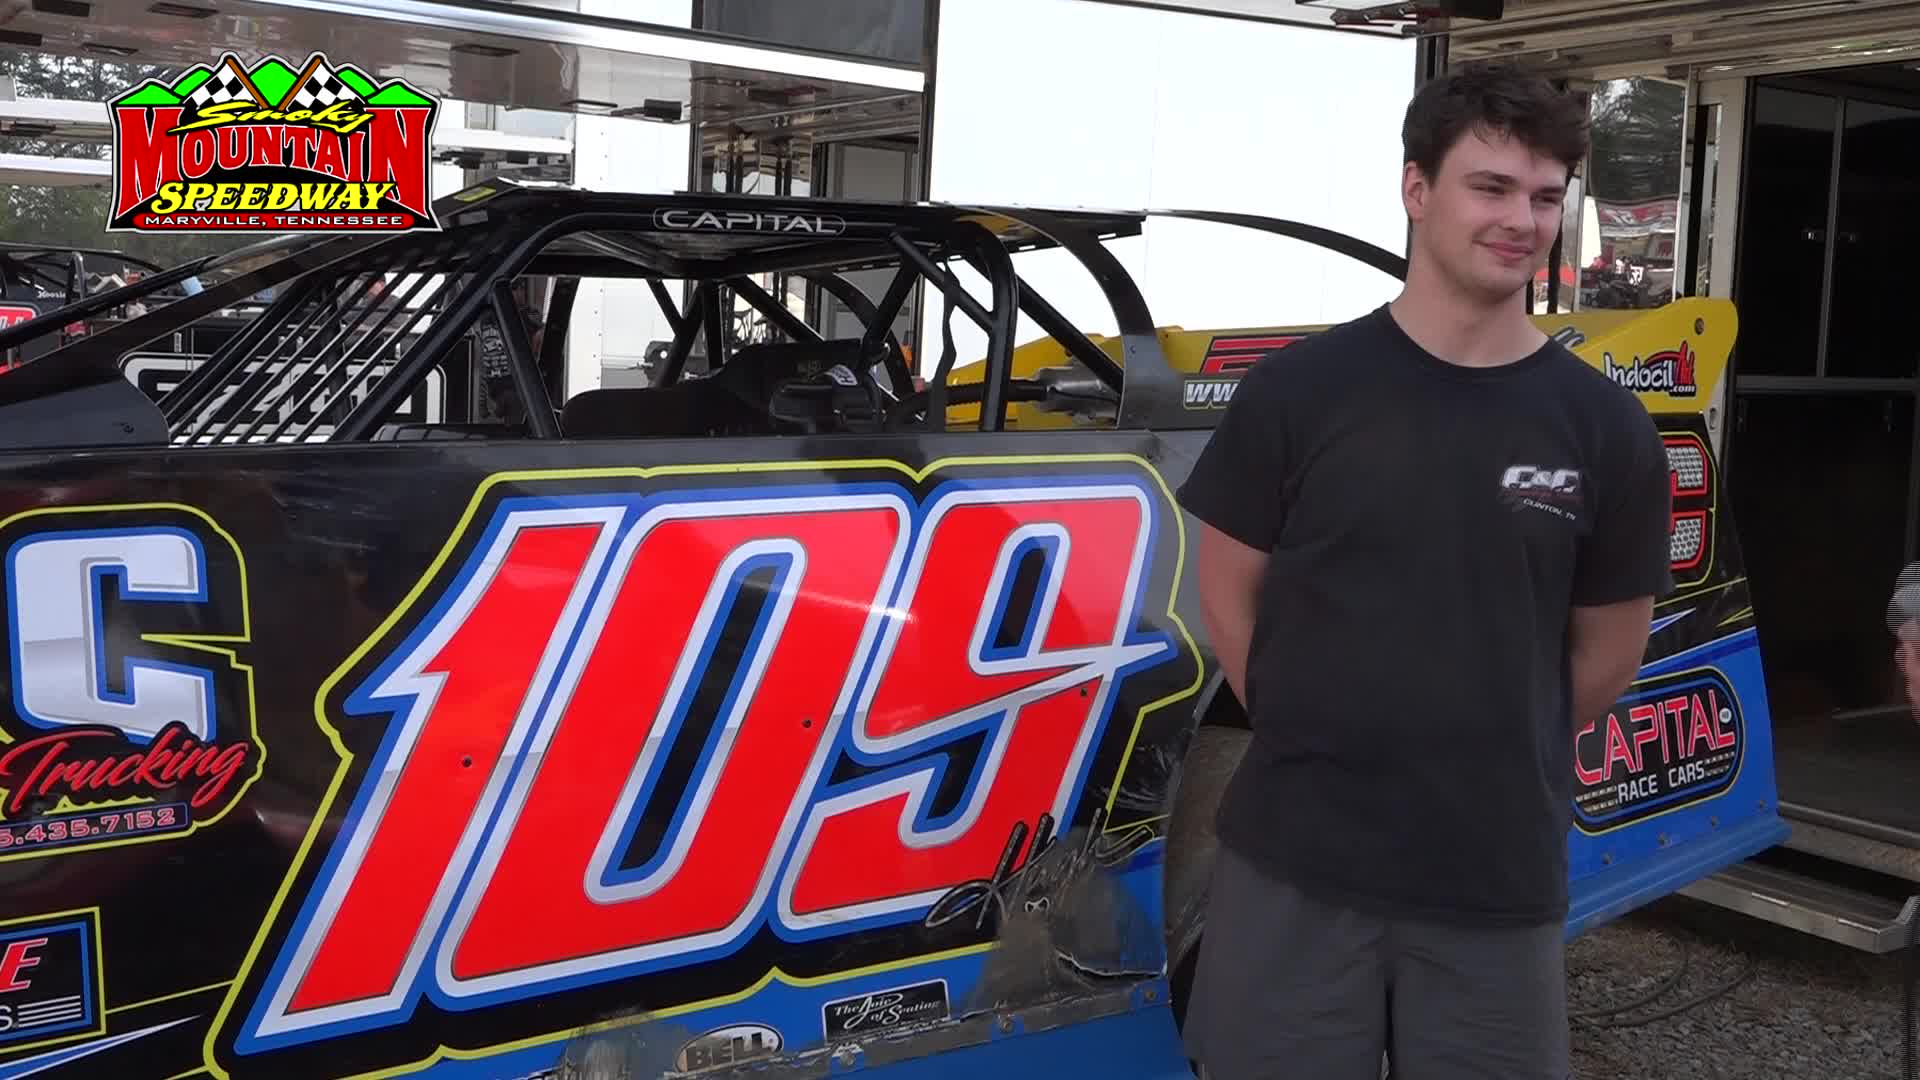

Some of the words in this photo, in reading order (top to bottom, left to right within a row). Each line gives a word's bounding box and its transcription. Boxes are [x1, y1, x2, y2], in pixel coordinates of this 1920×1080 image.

[660, 209, 838, 235] CAPITAL
[8, 529, 214, 743] C
[0, 727, 250, 813] Trucking
[246, 481, 1172, 1046] 109
[1574, 689, 1736, 786] CAPITAL
[1617, 774, 1659, 805] RACE
[1668, 759, 1706, 789] CARS
[686, 1032, 774, 1072] BELL
